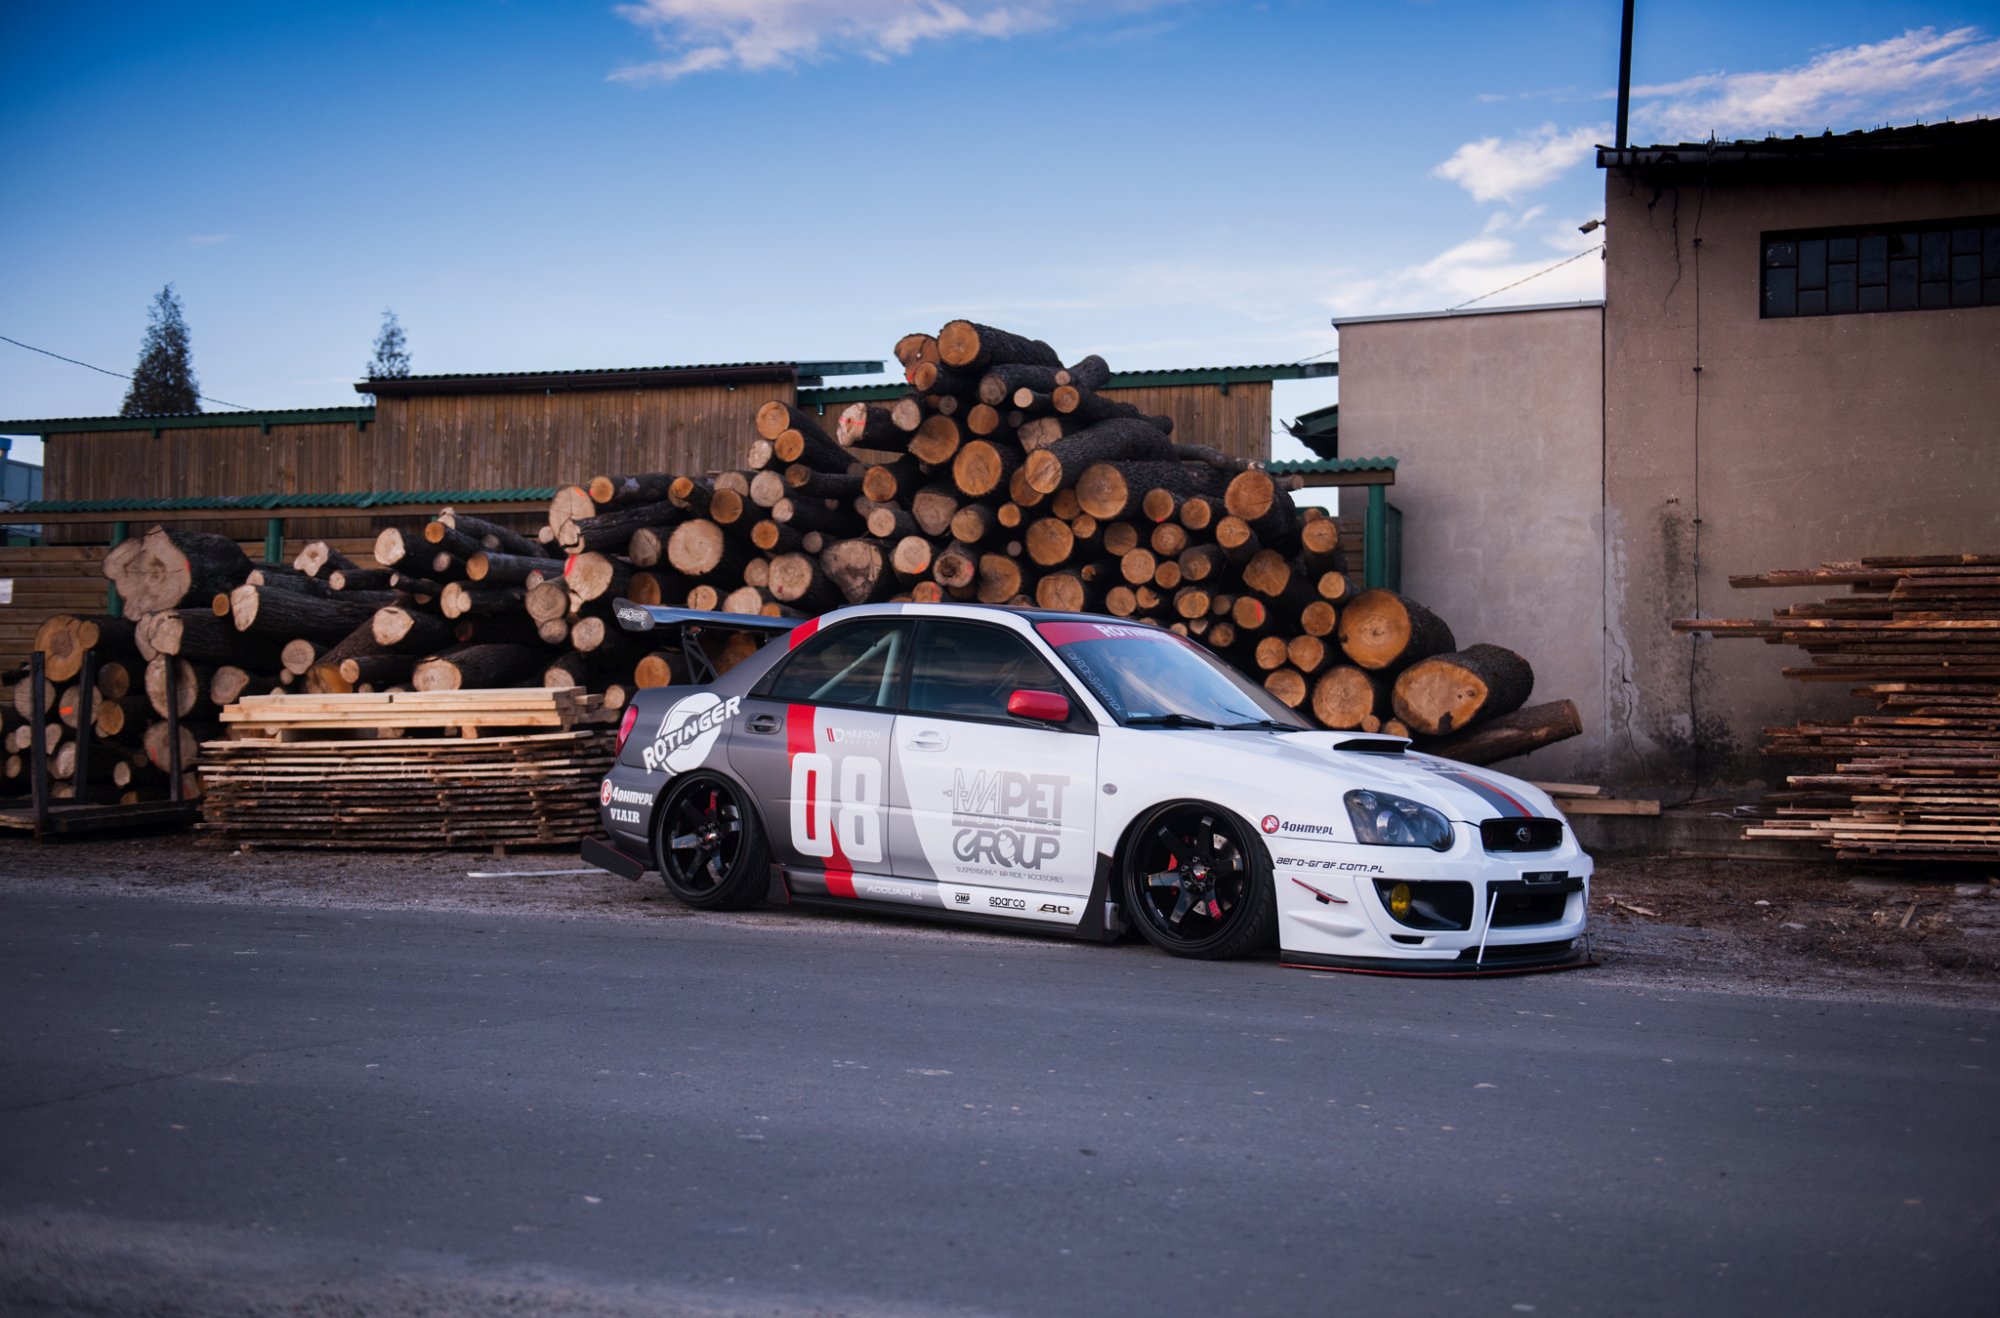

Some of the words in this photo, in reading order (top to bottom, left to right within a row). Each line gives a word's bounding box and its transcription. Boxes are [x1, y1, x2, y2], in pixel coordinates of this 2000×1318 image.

[642, 695, 741, 774] ROTINGER
[845, 729, 881, 741] MAXTON
[952, 767, 1071, 820] MAPET
[610, 807, 640, 823] VIAIR
[790, 752, 883, 863] 08
[958, 814, 1056, 832] TUNING
[952, 827, 1061, 870] GROUP
[955, 894, 971, 903] OMP
[988, 896, 1026, 908] sparco
